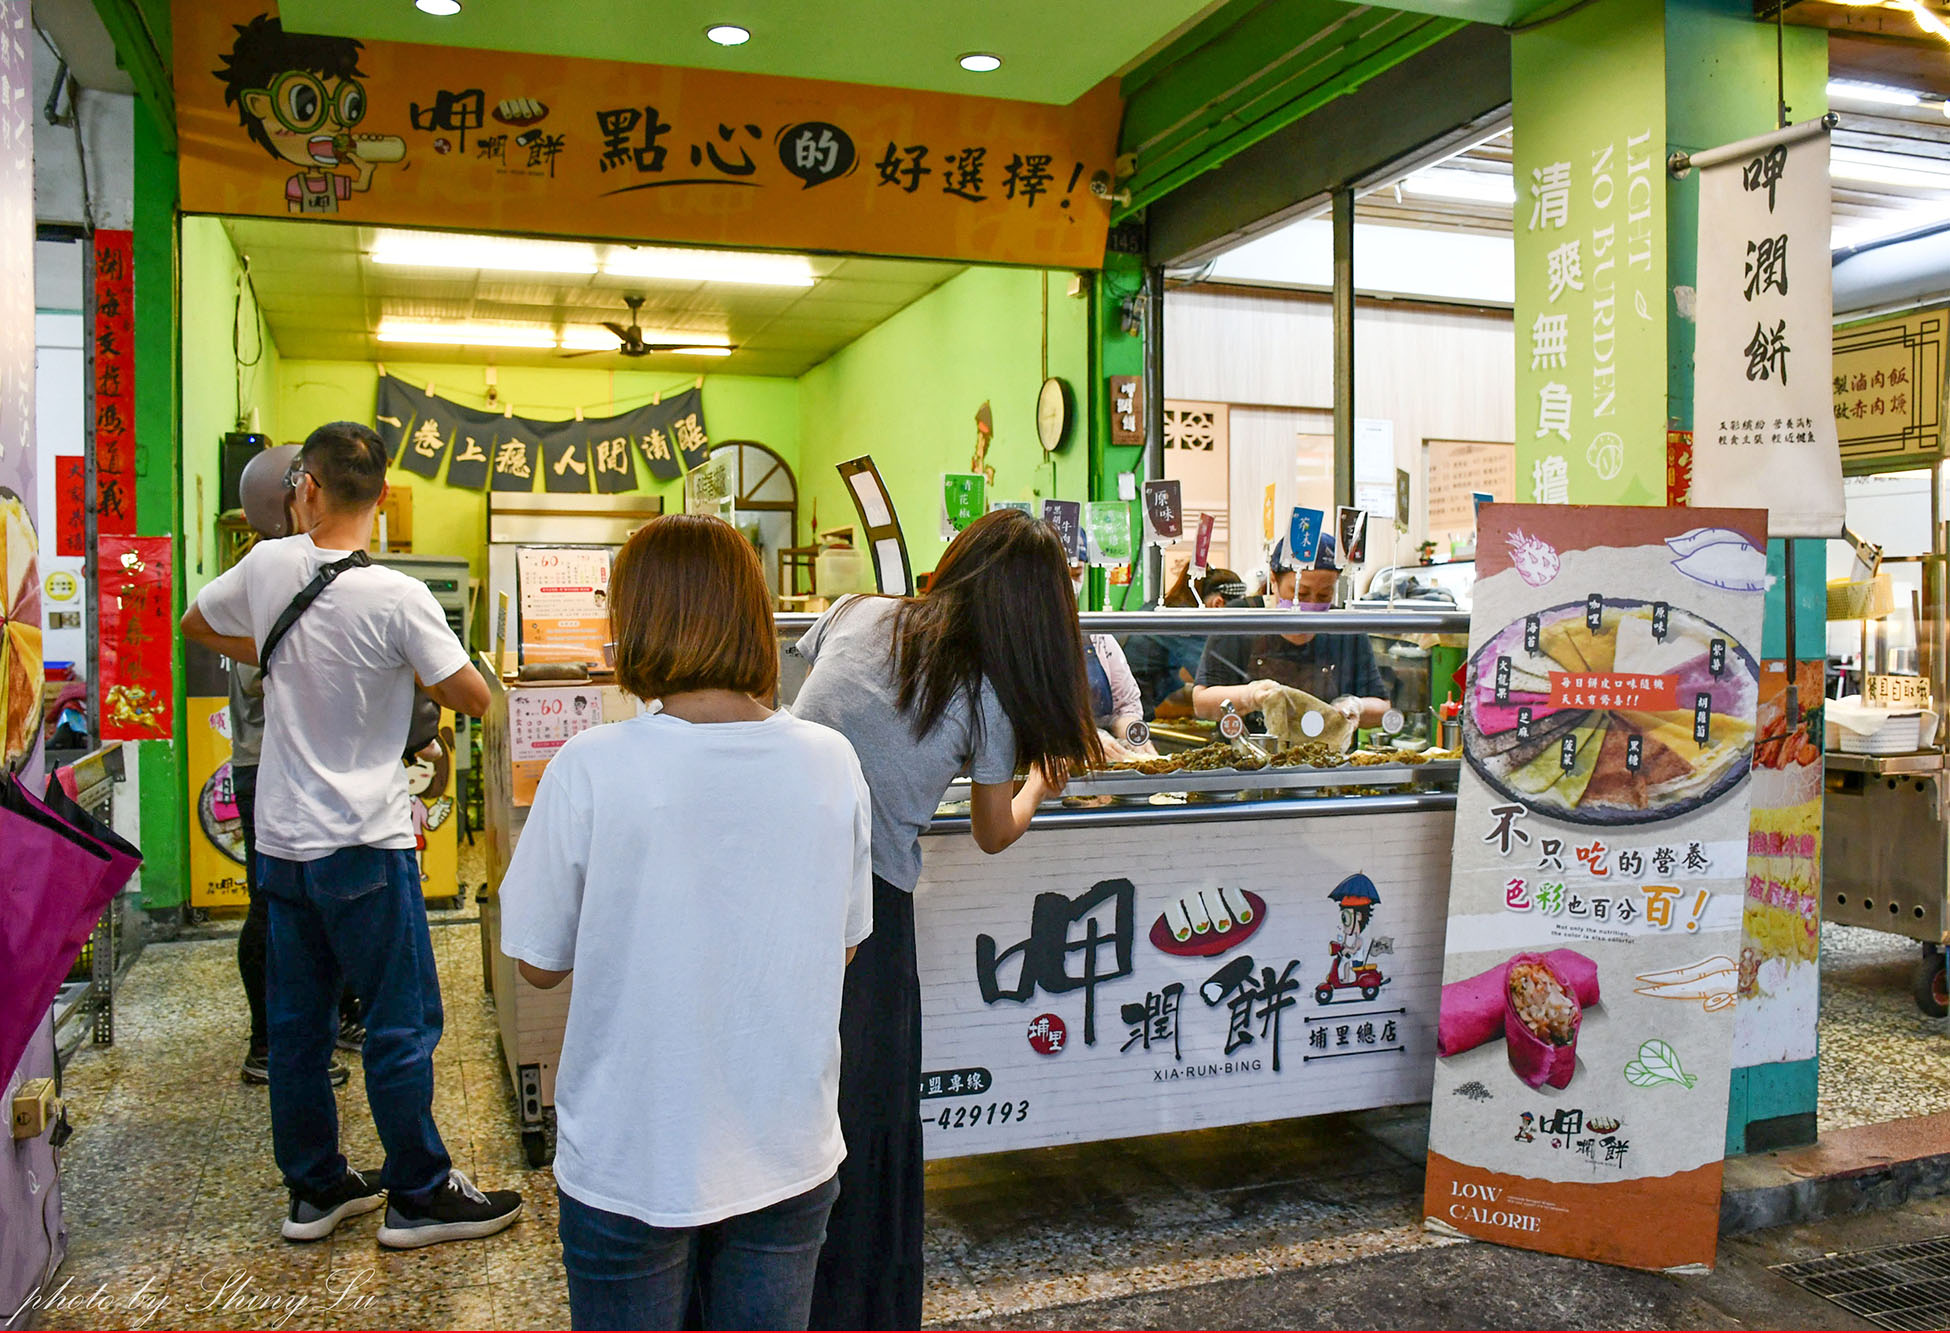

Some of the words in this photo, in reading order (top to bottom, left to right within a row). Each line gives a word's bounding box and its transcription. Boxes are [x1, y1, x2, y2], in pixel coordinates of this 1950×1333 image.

[1592, 144, 1615, 207] NO
[1627, 128, 1651, 271] LIGHT
[1743, 145, 1790, 387] 呷潤餅
[1528, 161, 1585, 504] 清爽無負擔
[1592, 223, 1616, 419] BURDEN
[1154, 490, 1174, 521] 原味
[541, 555, 559, 567] 60
[1526, 622, 1539, 648] 海苔
[1653, 607, 1666, 633] 原味
[541, 699, 563, 716] 60
[1517, 712, 1530, 738] 芝麻
[1563, 739, 1574, 765] 菠菜
[1484, 805, 1708, 876] 不只吃的營養
[1506, 878, 1708, 931] 色彩也百分百!
[1028, 1019, 1064, 1052] 埔里
[1309, 1020, 1398, 1050] 埔里總店
[919, 1072, 985, 1094] 盟專線
[1451, 1181, 1502, 1202] LOW
[1450, 1204, 1541, 1233] CALORIE
